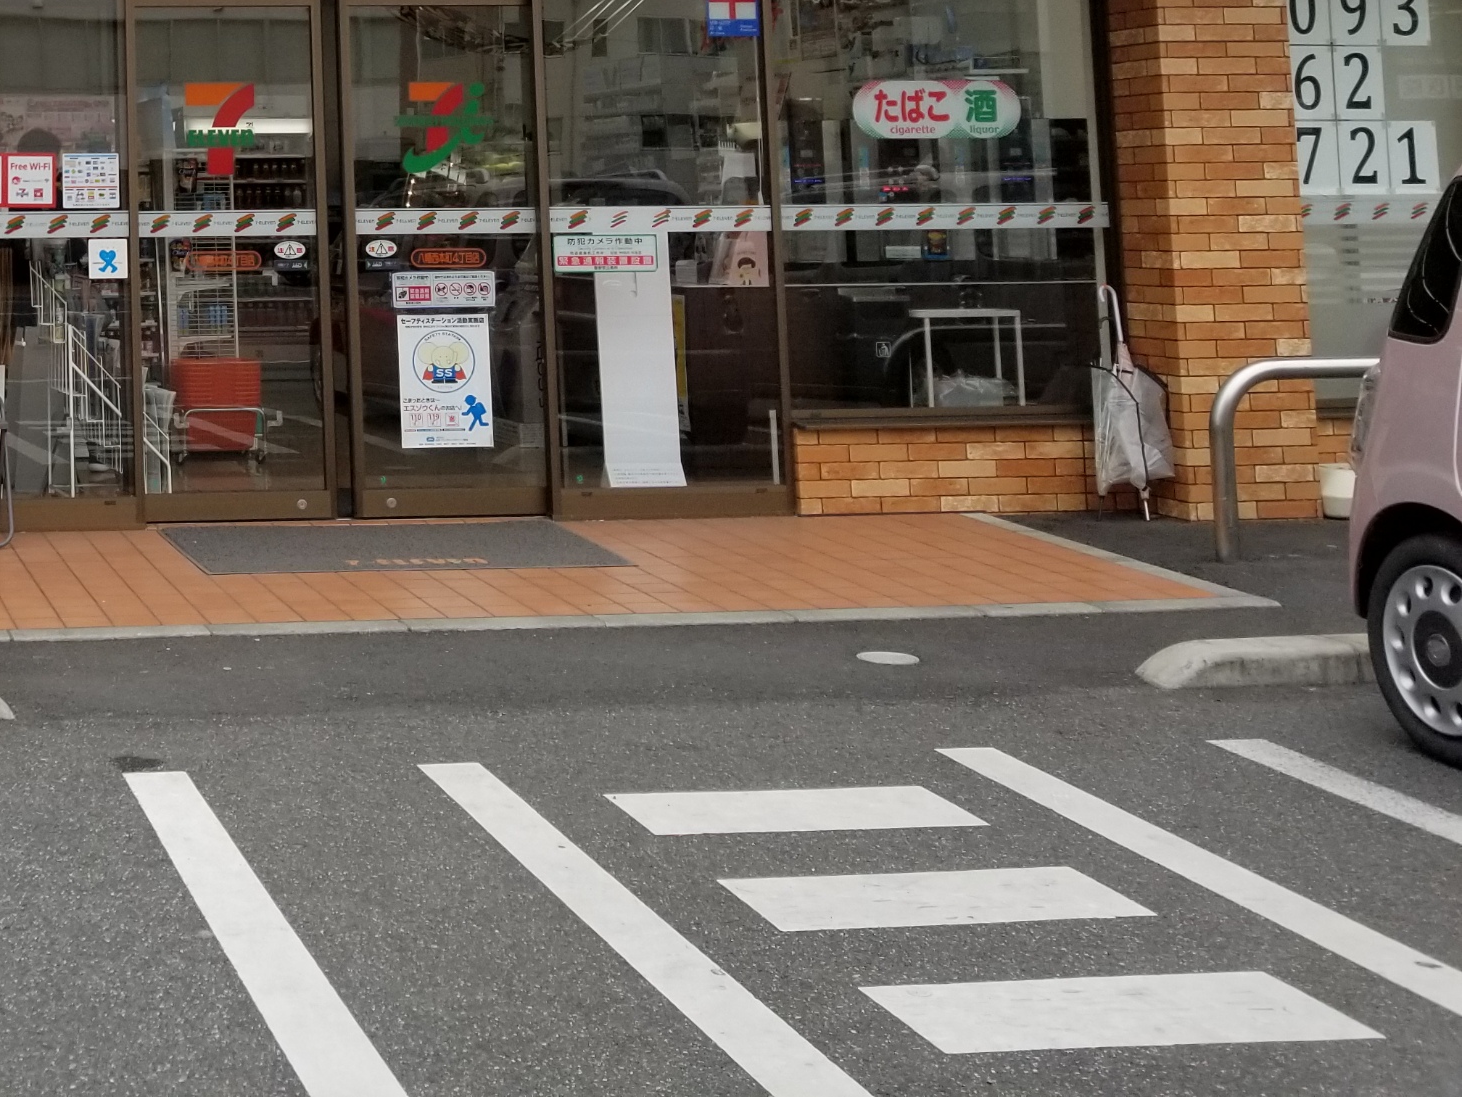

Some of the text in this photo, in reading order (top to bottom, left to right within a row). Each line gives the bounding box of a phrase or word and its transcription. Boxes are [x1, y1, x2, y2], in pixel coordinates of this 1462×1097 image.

[1294, 53, 1372, 110] 62
[874, 88, 950, 123] たばこ
[965, 89, 997, 123] 酒
[890, 124, 936, 136] cigarette
[969, 124, 1001, 136] liquor
[1296, 126, 1427, 185] 721
[10, 162, 51, 171] Free Wi-Fi
[567, 238, 643, 246] 防犯カメラ作動中
[436, 368, 453, 377] SS
